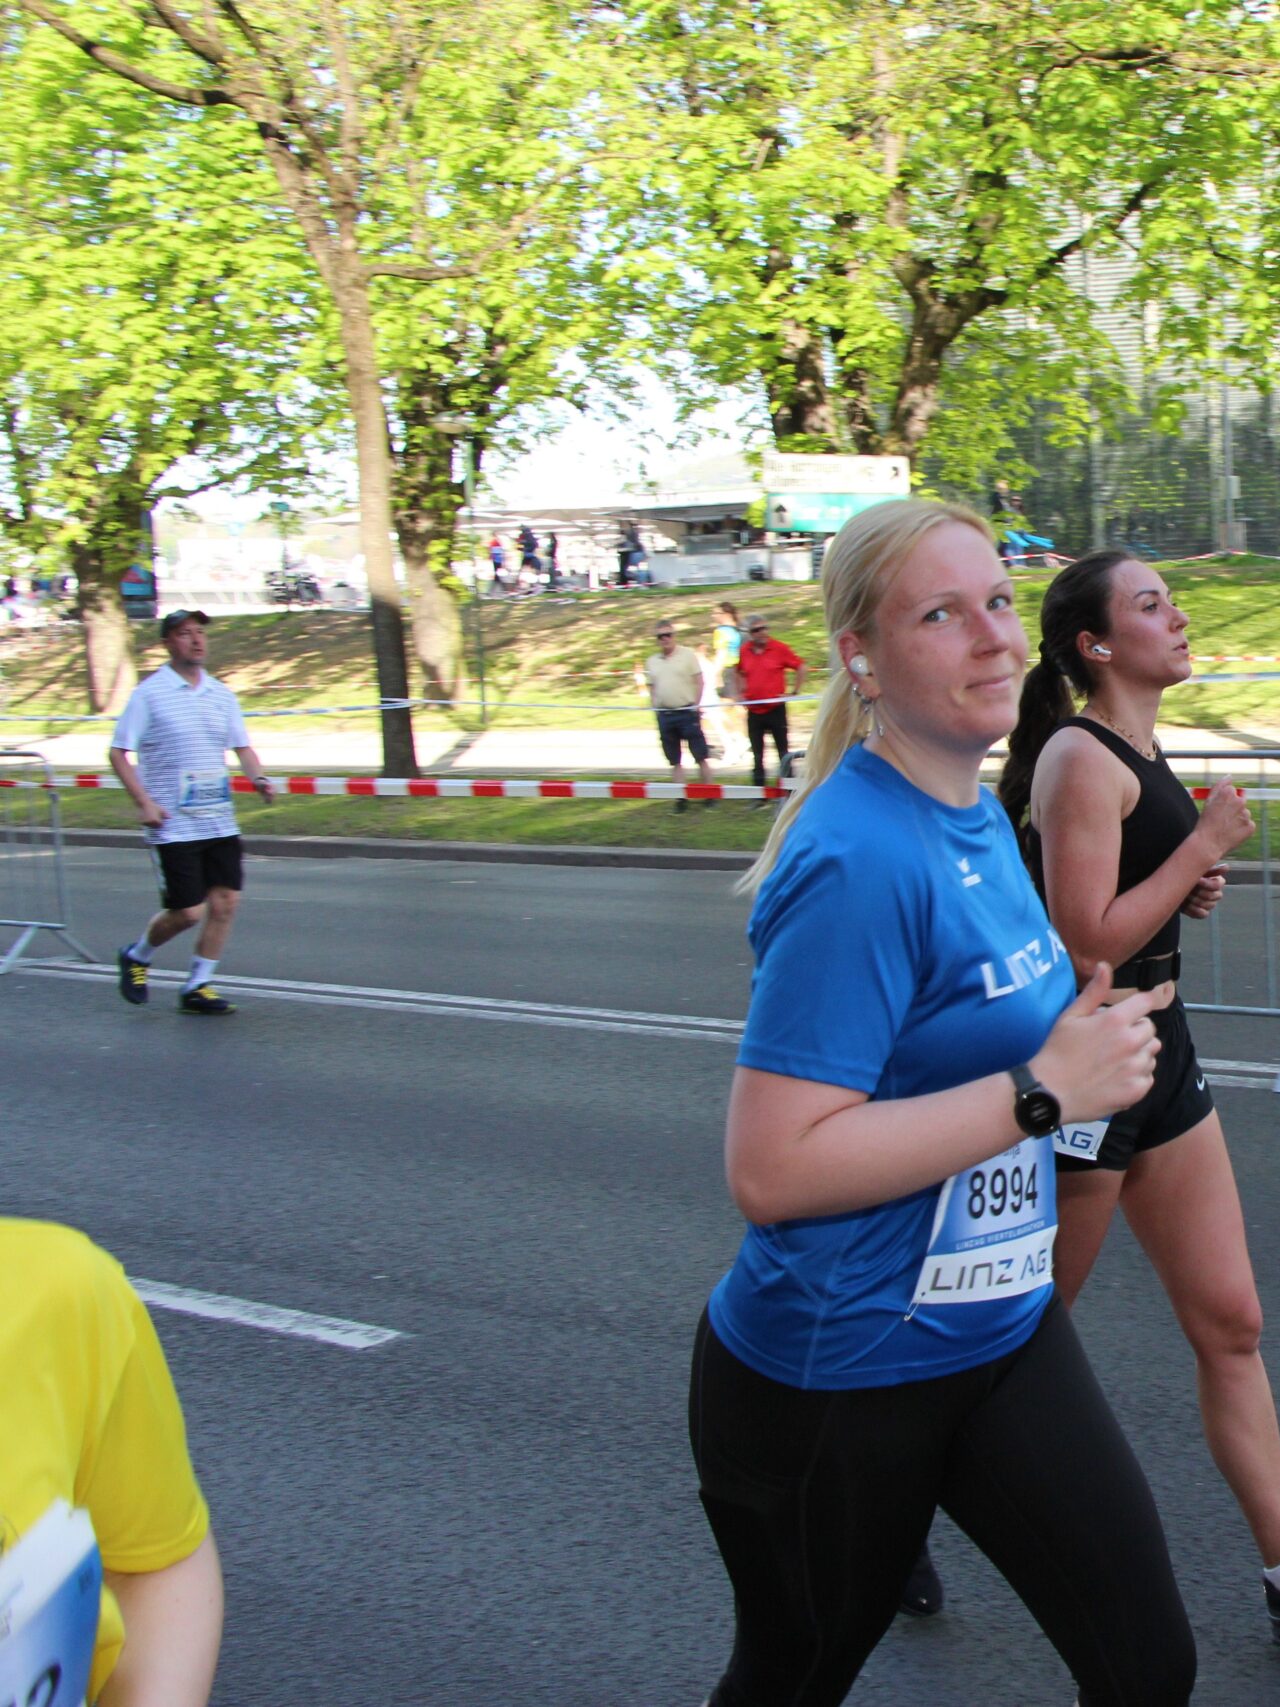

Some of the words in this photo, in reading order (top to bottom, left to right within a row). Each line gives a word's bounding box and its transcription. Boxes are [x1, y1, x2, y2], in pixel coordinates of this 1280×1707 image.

[981, 939, 1052, 999] LINZ
[968, 1162, 1038, 1219] 8994
[930, 1258, 1014, 1291] LINZ
[1021, 1249, 1047, 1280] AG
